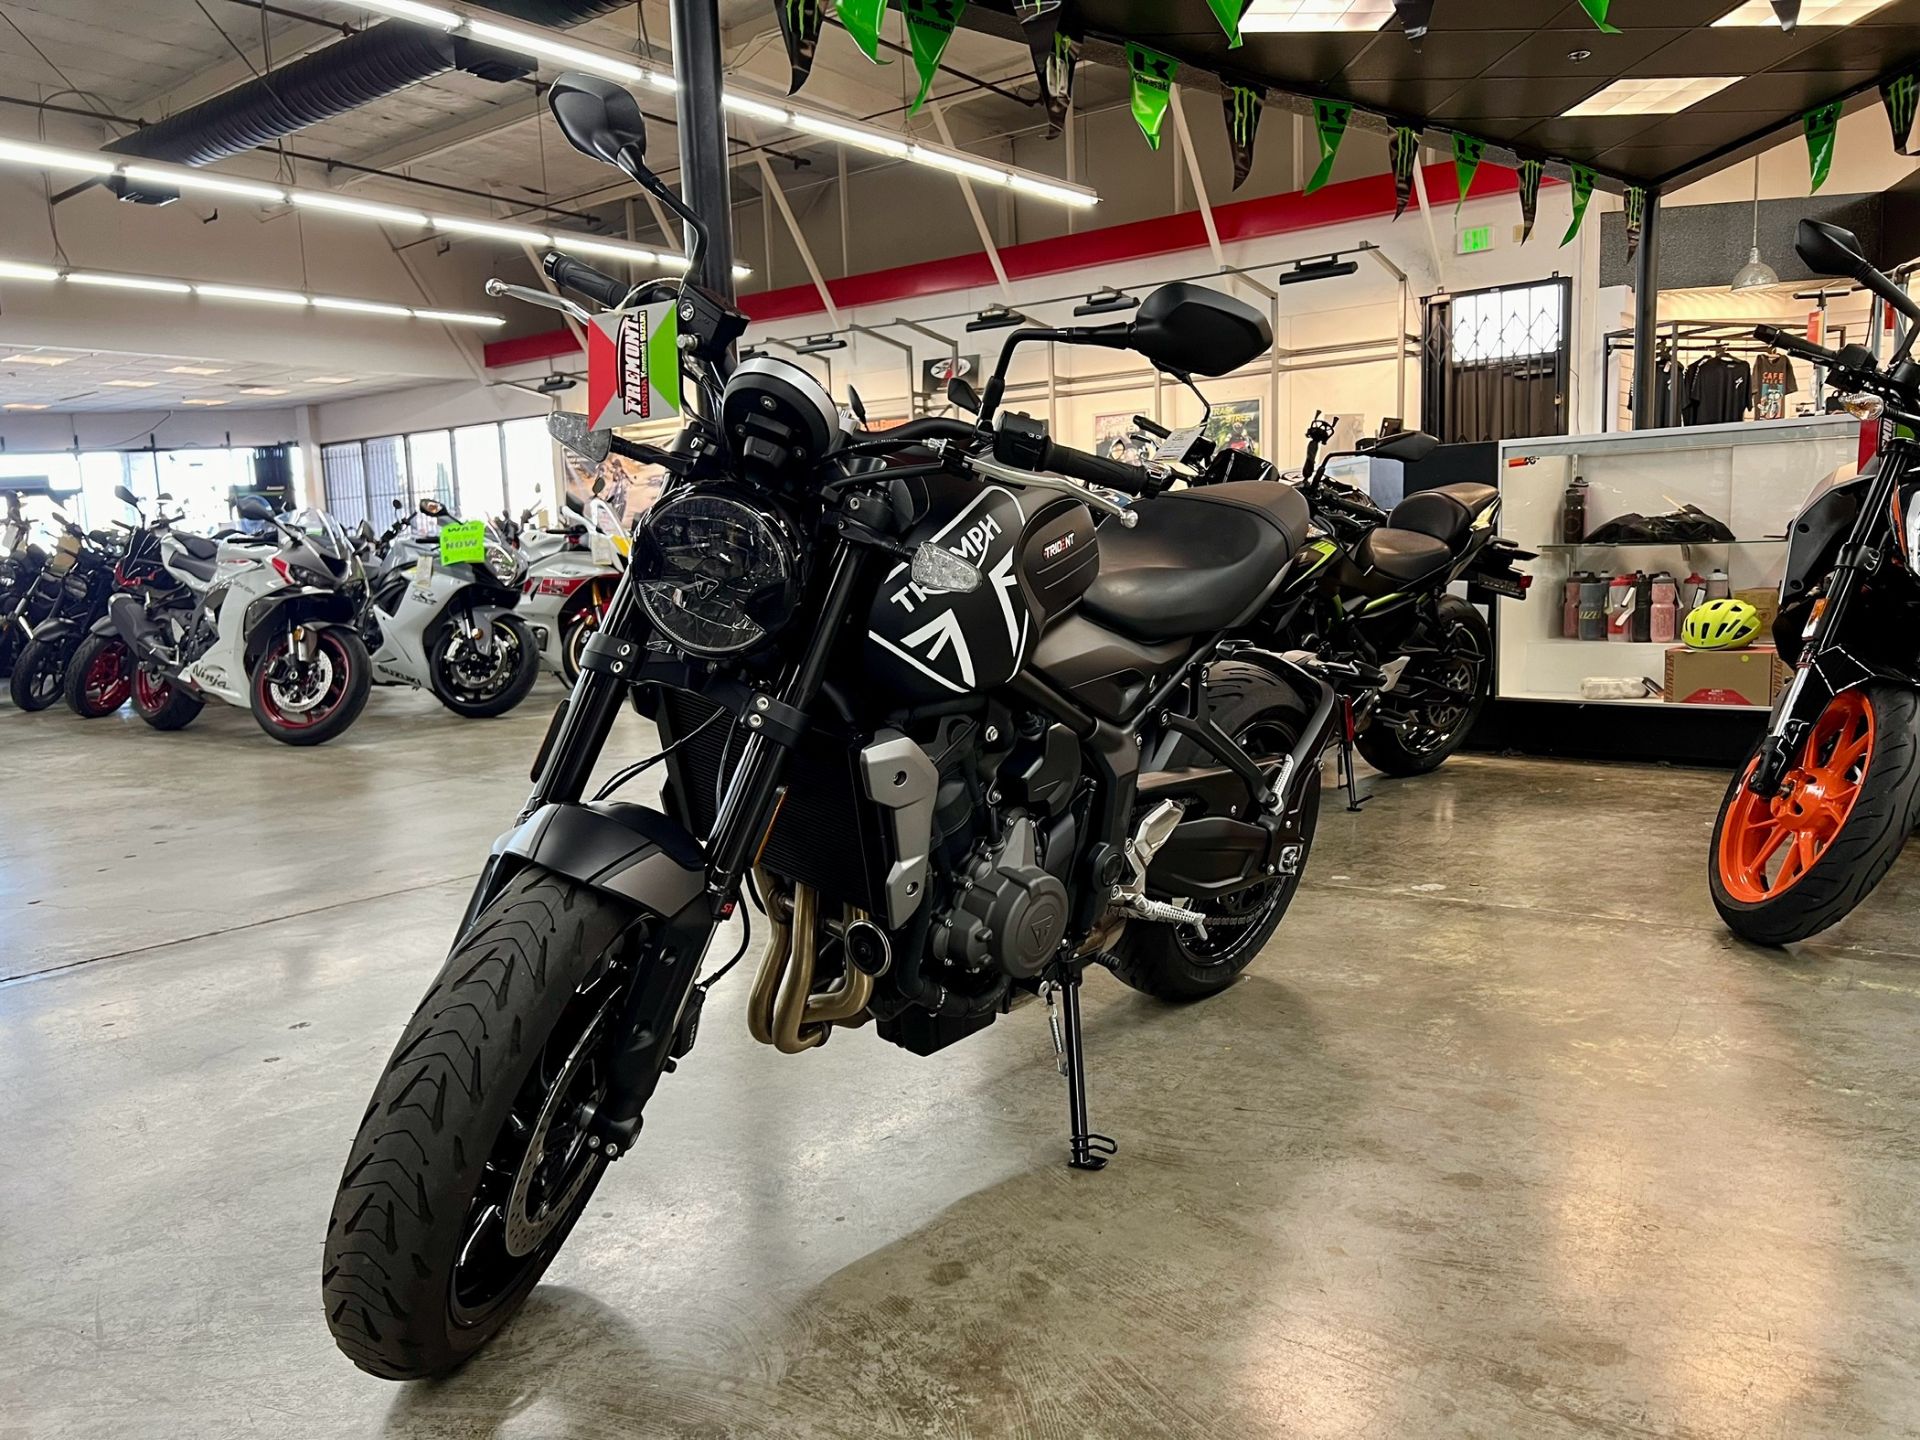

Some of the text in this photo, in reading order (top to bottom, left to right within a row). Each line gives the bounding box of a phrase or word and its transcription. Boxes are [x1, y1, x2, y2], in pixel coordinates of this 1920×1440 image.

[1463, 227, 1488, 252] EXIT
[639, 311, 647, 341] SUZUKI
[624, 315, 641, 414] FREMONT
[1763, 371, 1785, 380] CAFE
[447, 525, 479, 533] WAS
[445, 539, 478, 550] NOW
[1043, 532, 1076, 559] TRIDENT
[890, 513, 1003, 614] TRMPH
[192, 664, 231, 690] Ninja
[377, 664, 422, 687] SUZUKI
